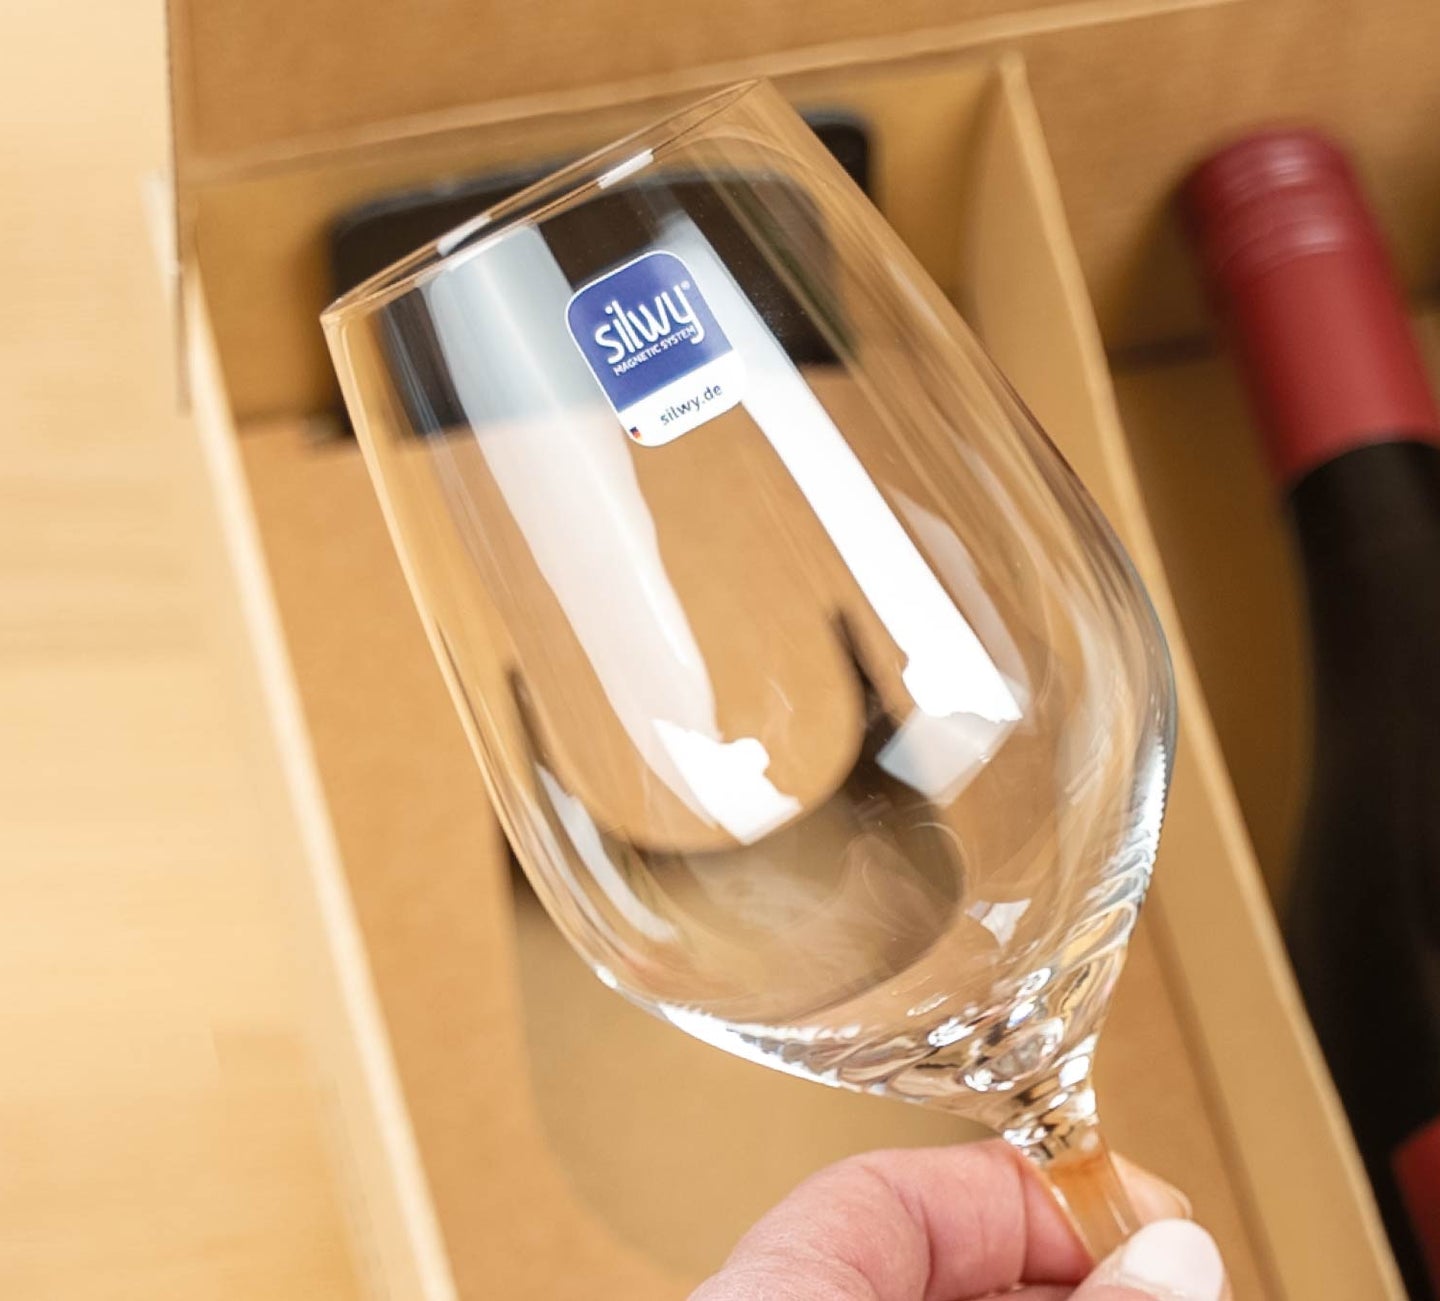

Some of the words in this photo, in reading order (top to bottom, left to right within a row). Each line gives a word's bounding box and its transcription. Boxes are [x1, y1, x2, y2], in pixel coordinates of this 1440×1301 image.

[612, 343, 662, 377] MAGNETIC
[660, 325, 697, 350] SYSTEM
[660, 383, 723, 426] silwy.de
